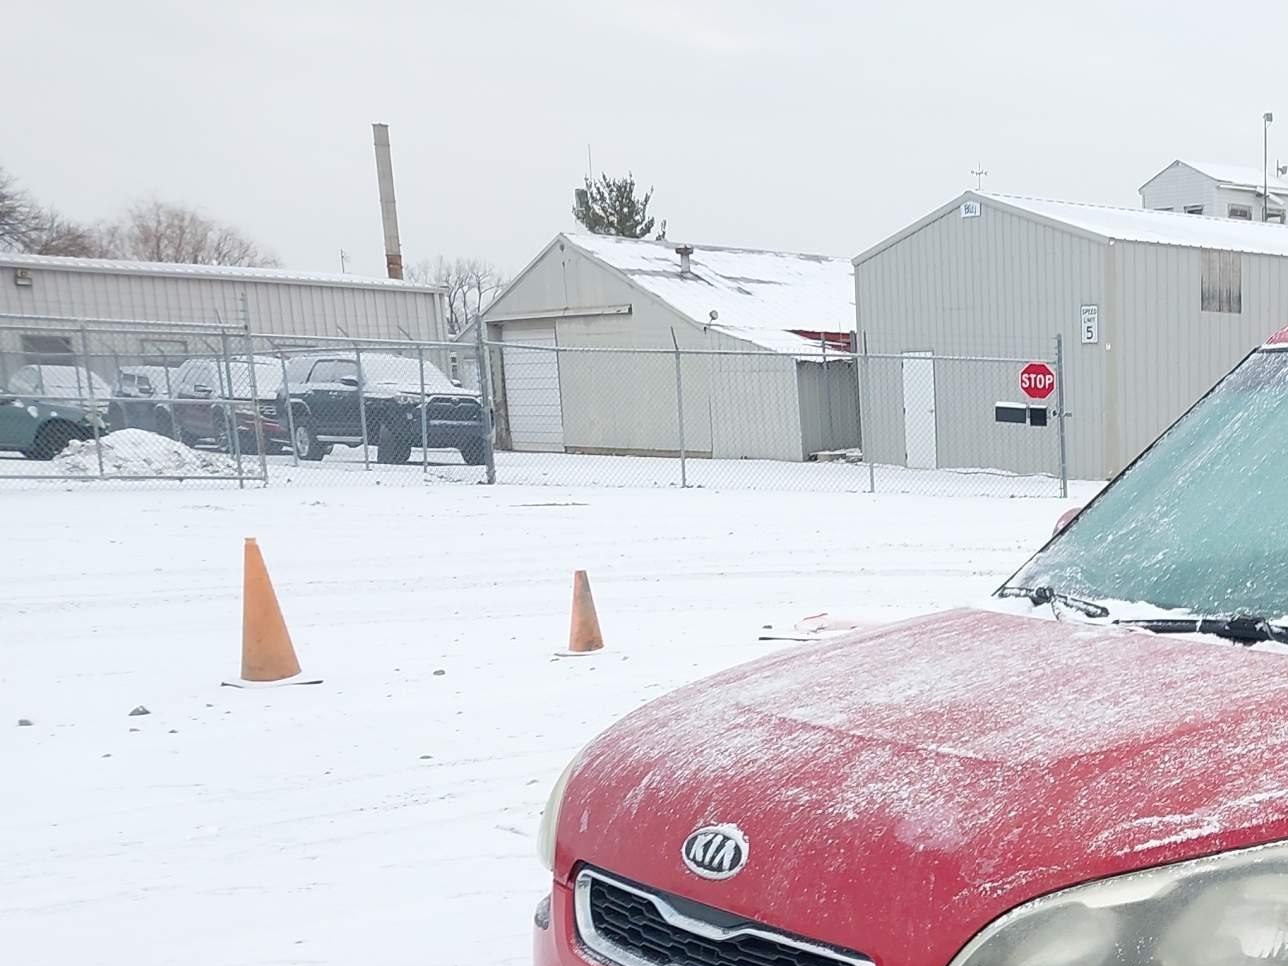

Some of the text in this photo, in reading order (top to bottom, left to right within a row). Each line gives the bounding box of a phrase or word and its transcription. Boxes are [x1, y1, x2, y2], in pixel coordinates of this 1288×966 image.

[1086, 326, 1094, 340] 5
[1021, 373, 1054, 390] STOP
[689, 833, 736, 871] KIA
